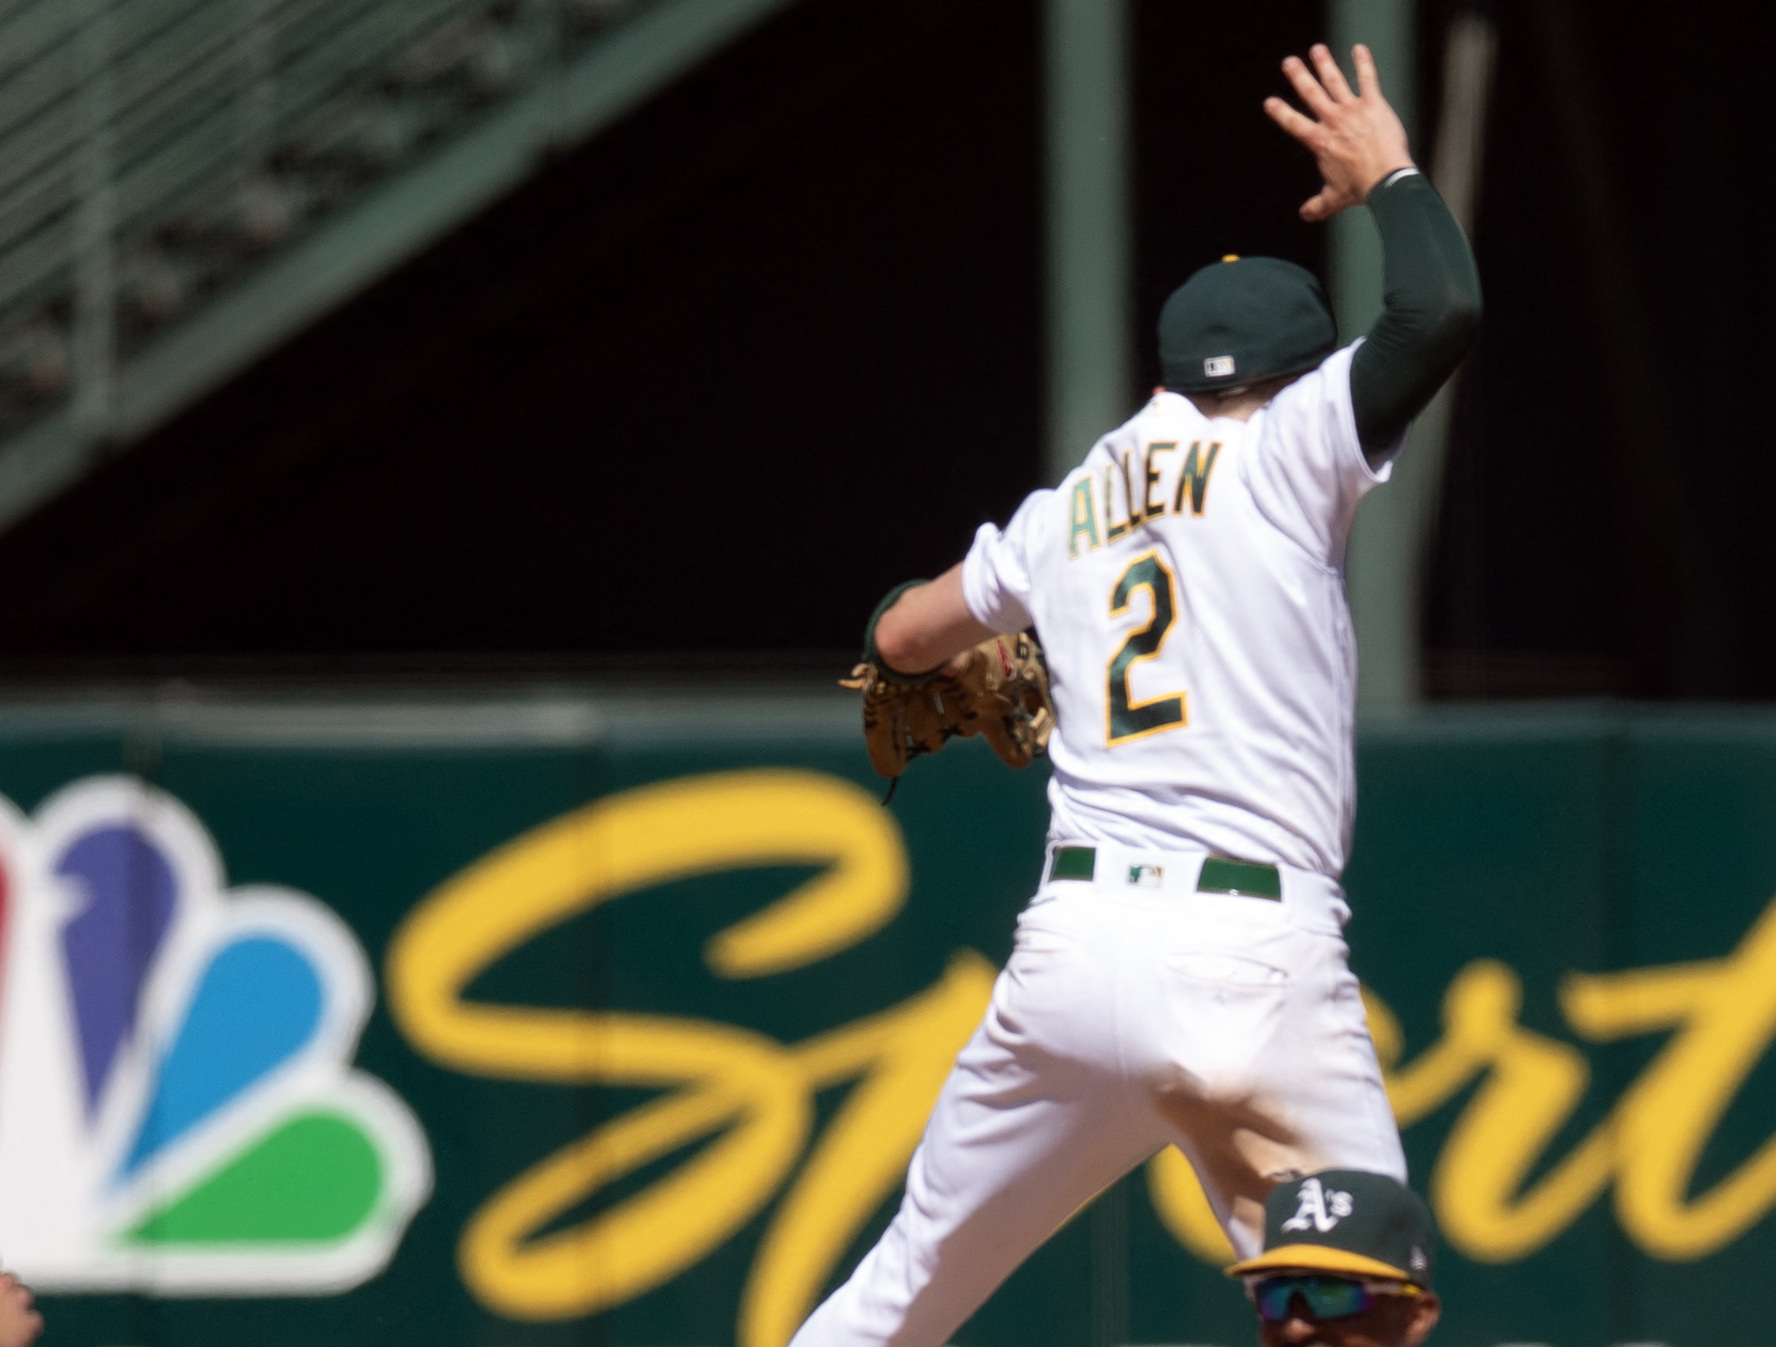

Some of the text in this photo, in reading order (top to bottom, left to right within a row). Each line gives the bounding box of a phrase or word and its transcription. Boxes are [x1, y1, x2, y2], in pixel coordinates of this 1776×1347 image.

[1069, 440, 1223, 560] ALLEN
[1106, 549, 1188, 748] 2
[1280, 1177, 1354, 1234] A's
